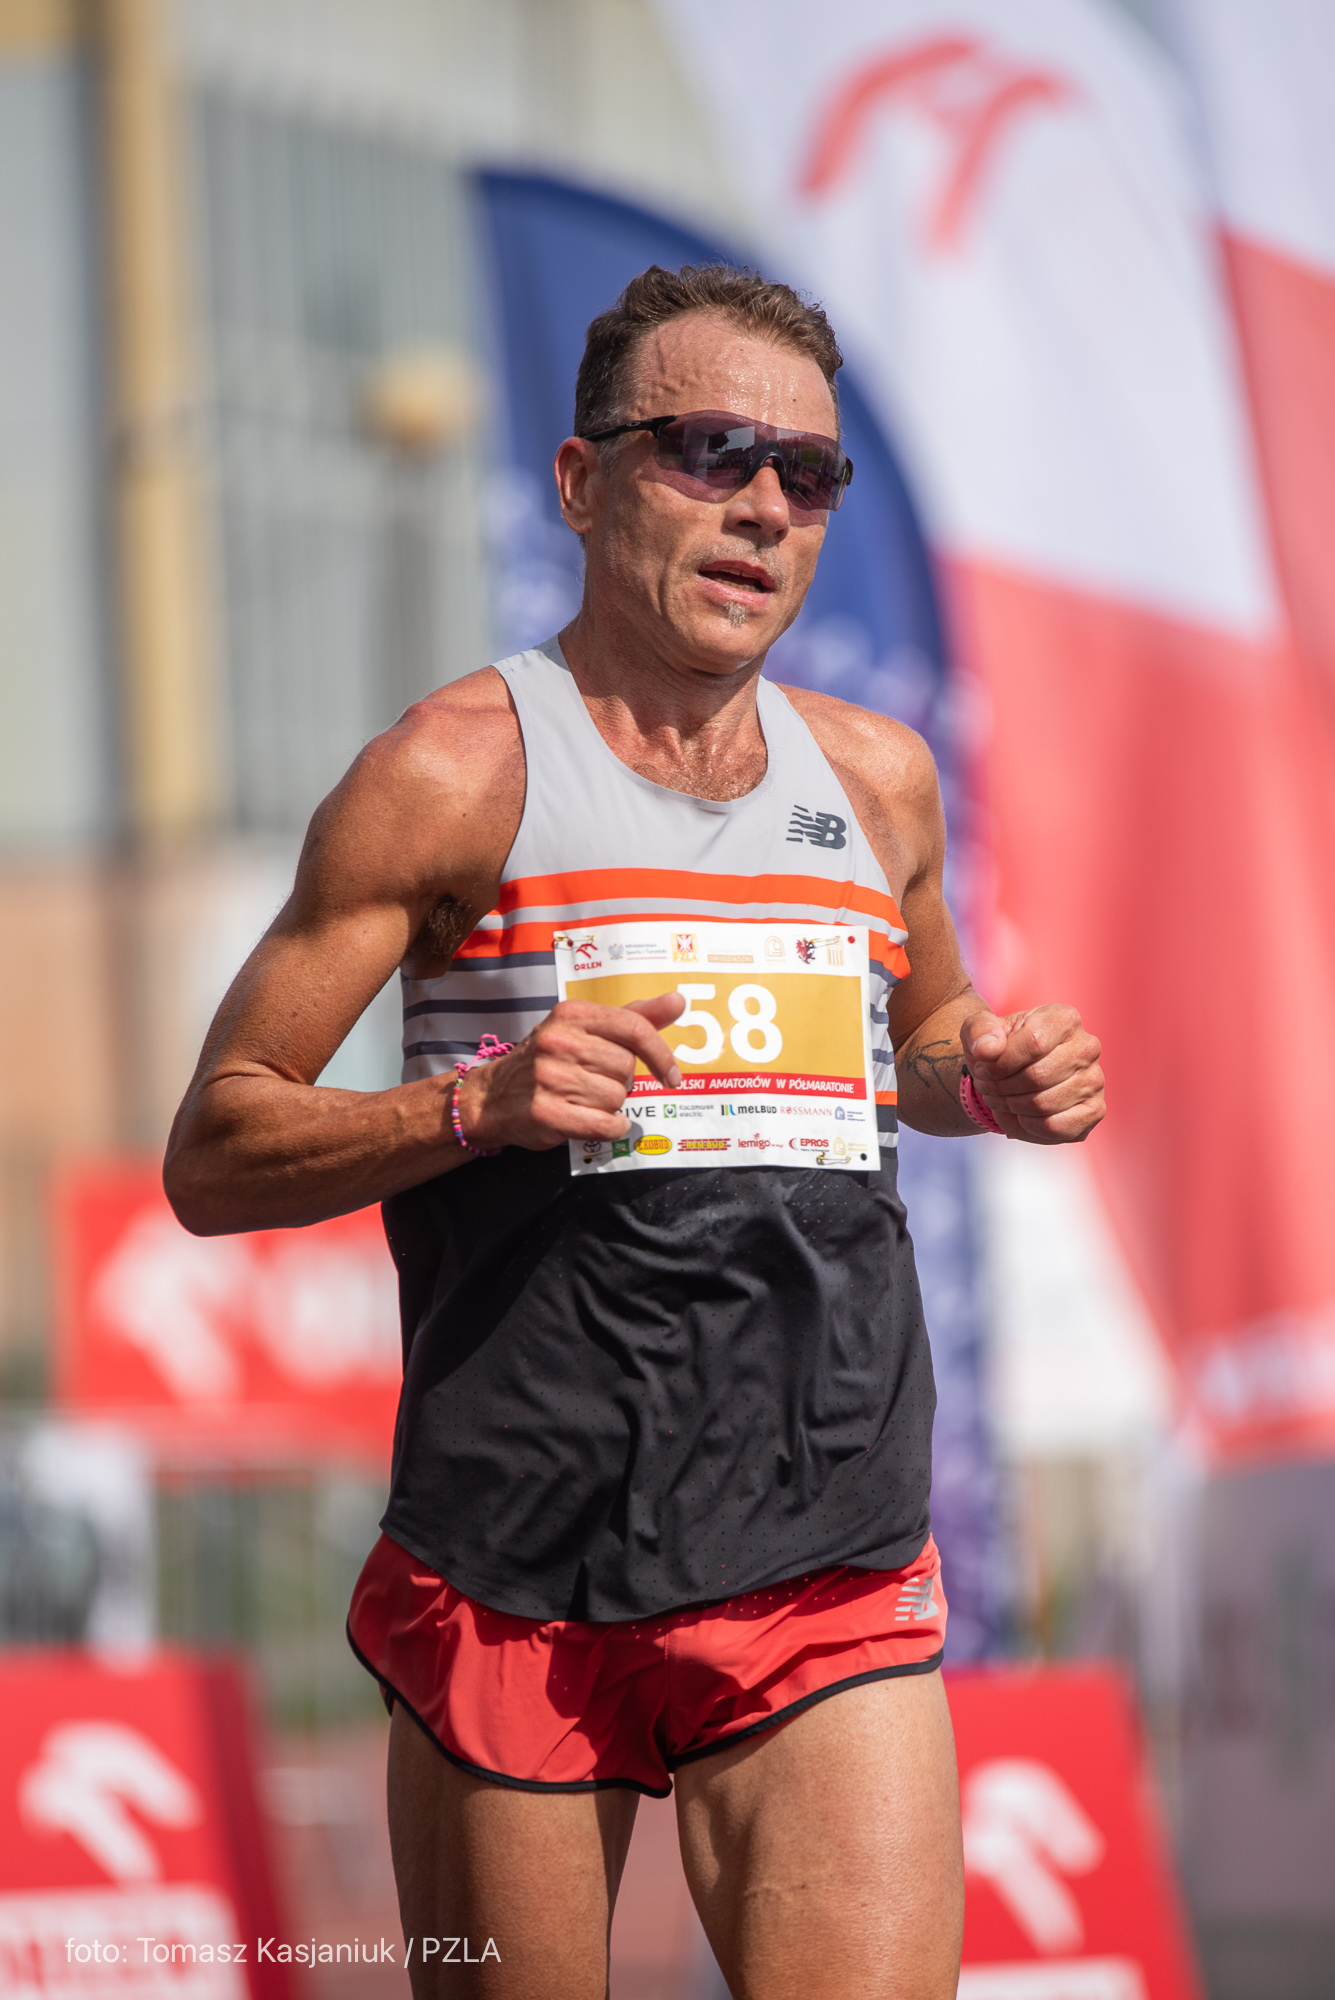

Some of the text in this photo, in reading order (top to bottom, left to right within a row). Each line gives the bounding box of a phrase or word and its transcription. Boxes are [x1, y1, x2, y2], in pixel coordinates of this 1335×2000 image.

[574, 961, 602, 971] ORLEN
[672, 983, 783, 1065] 58
[675, 1079, 705, 1090] OLSKI
[708, 1075, 771, 1089] AMATORÓW
[776, 1079, 786, 1089] W
[788, 1077, 855, 1094] PÓŁMARATONIE
[621, 1105, 656, 1118] IVE
[780, 1105, 832, 1116] ROSSMANN
[738, 1136, 770, 1150] lemigo
[800, 1138, 829, 1147] EPROS
